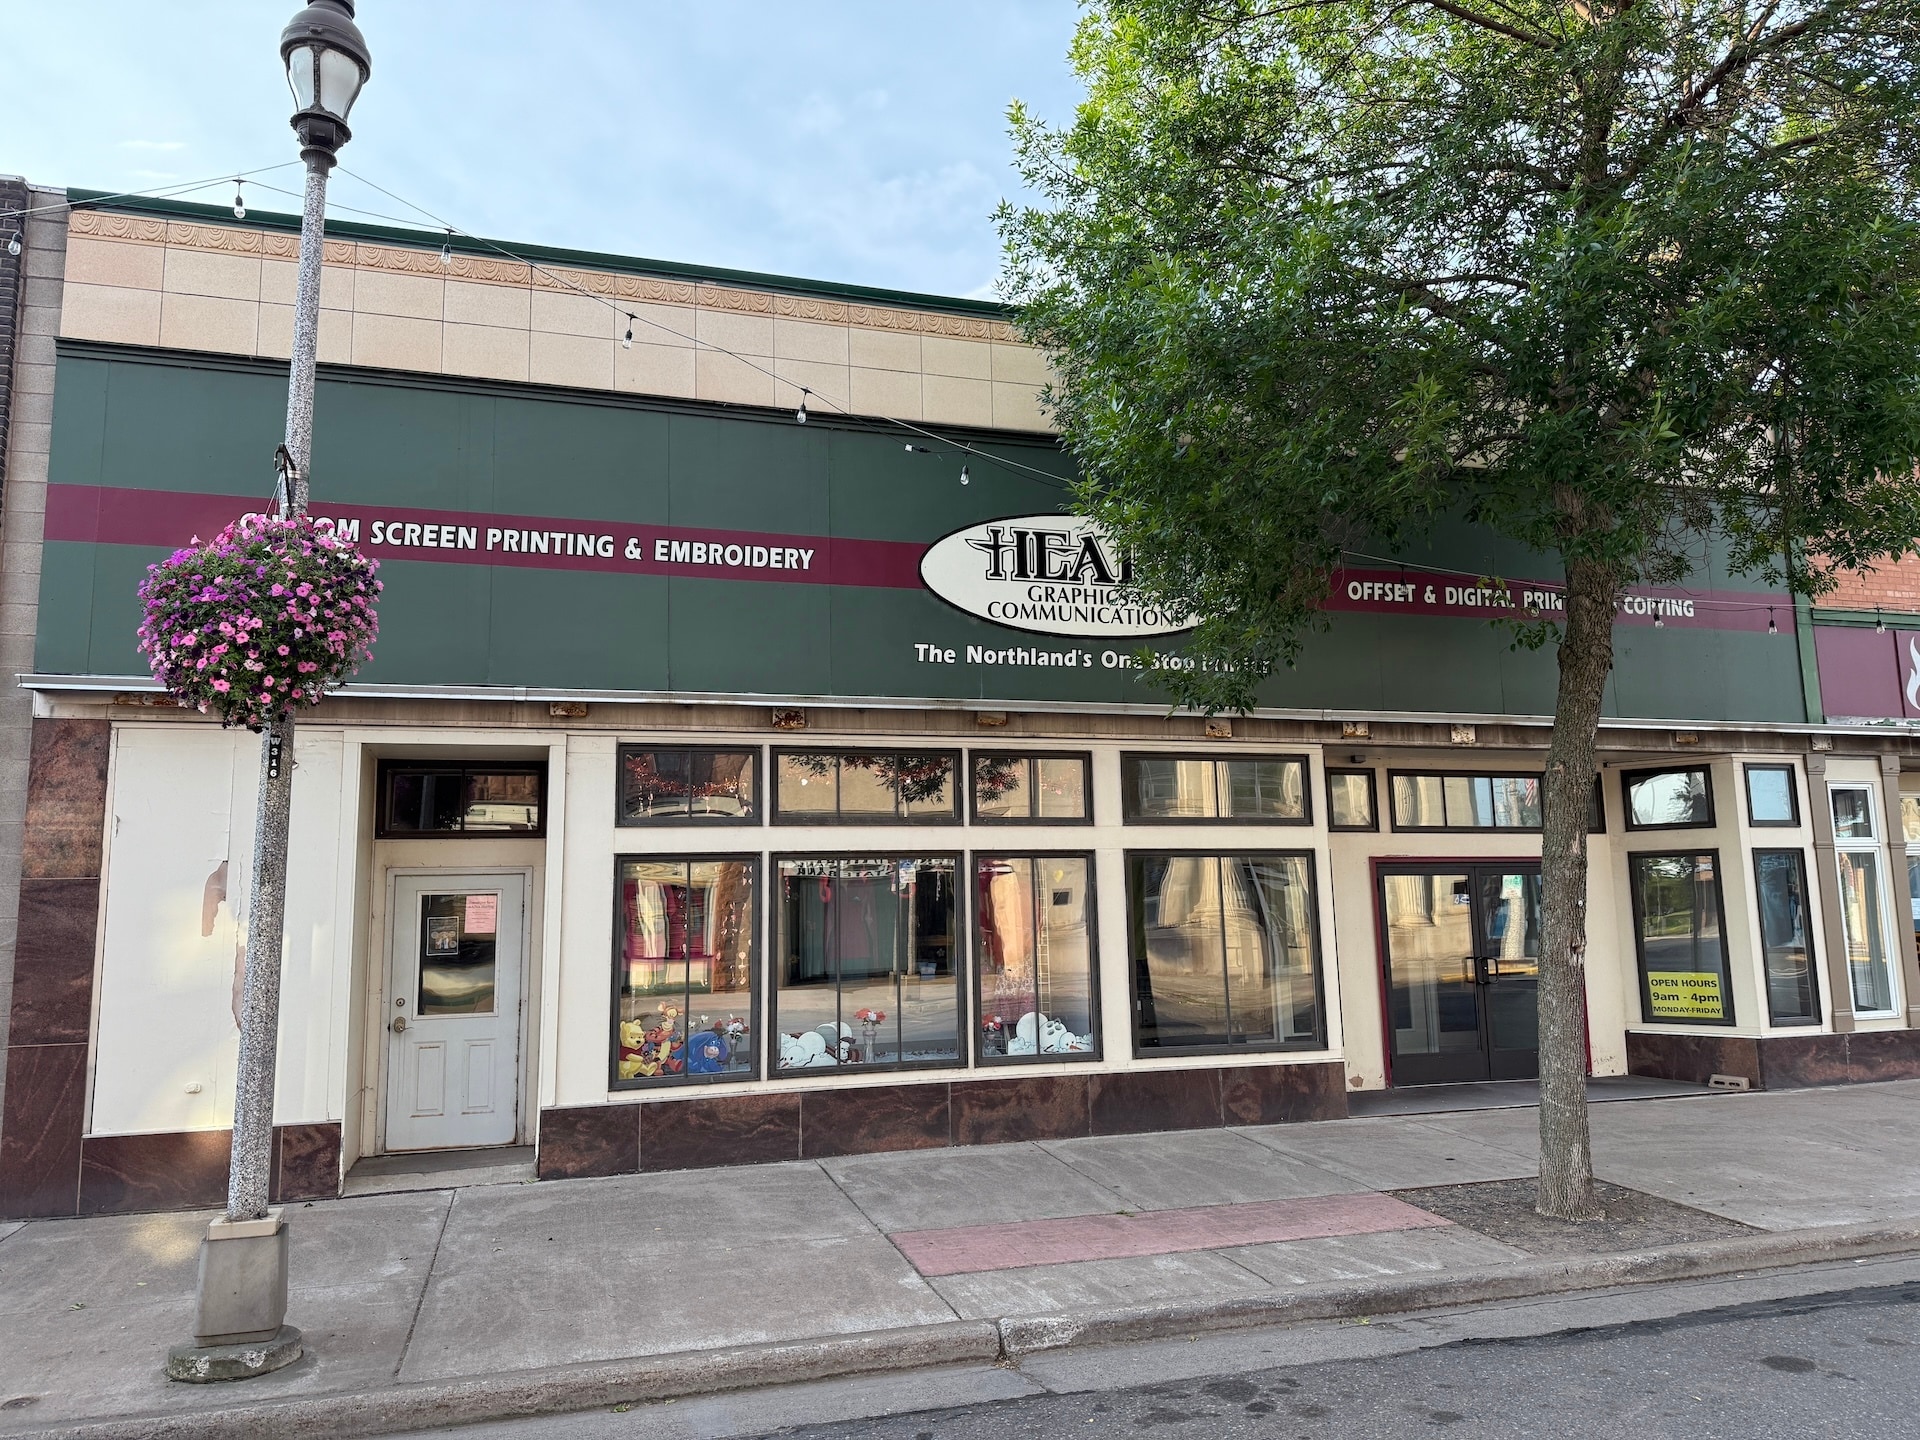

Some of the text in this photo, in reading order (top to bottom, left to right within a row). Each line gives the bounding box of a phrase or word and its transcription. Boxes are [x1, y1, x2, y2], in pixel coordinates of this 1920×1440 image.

[239, 512, 815, 570] COM SCREEN PRINTING & EMBROIDERY
[1347, 581, 1566, 611] OFFSET & DIGITAL PRIN
[1623, 596, 1695, 618] COPYING
[914, 643, 956, 664] The
[966, 645, 1092, 668] Northland's
[1651, 979, 1717, 988] OPEN HOURS
[1652, 992, 1679, 1001] 9am
[1691, 993, 1719, 1004] 4pm
[1653, 1006, 1721, 1014] MONDAY-FRIDAY
